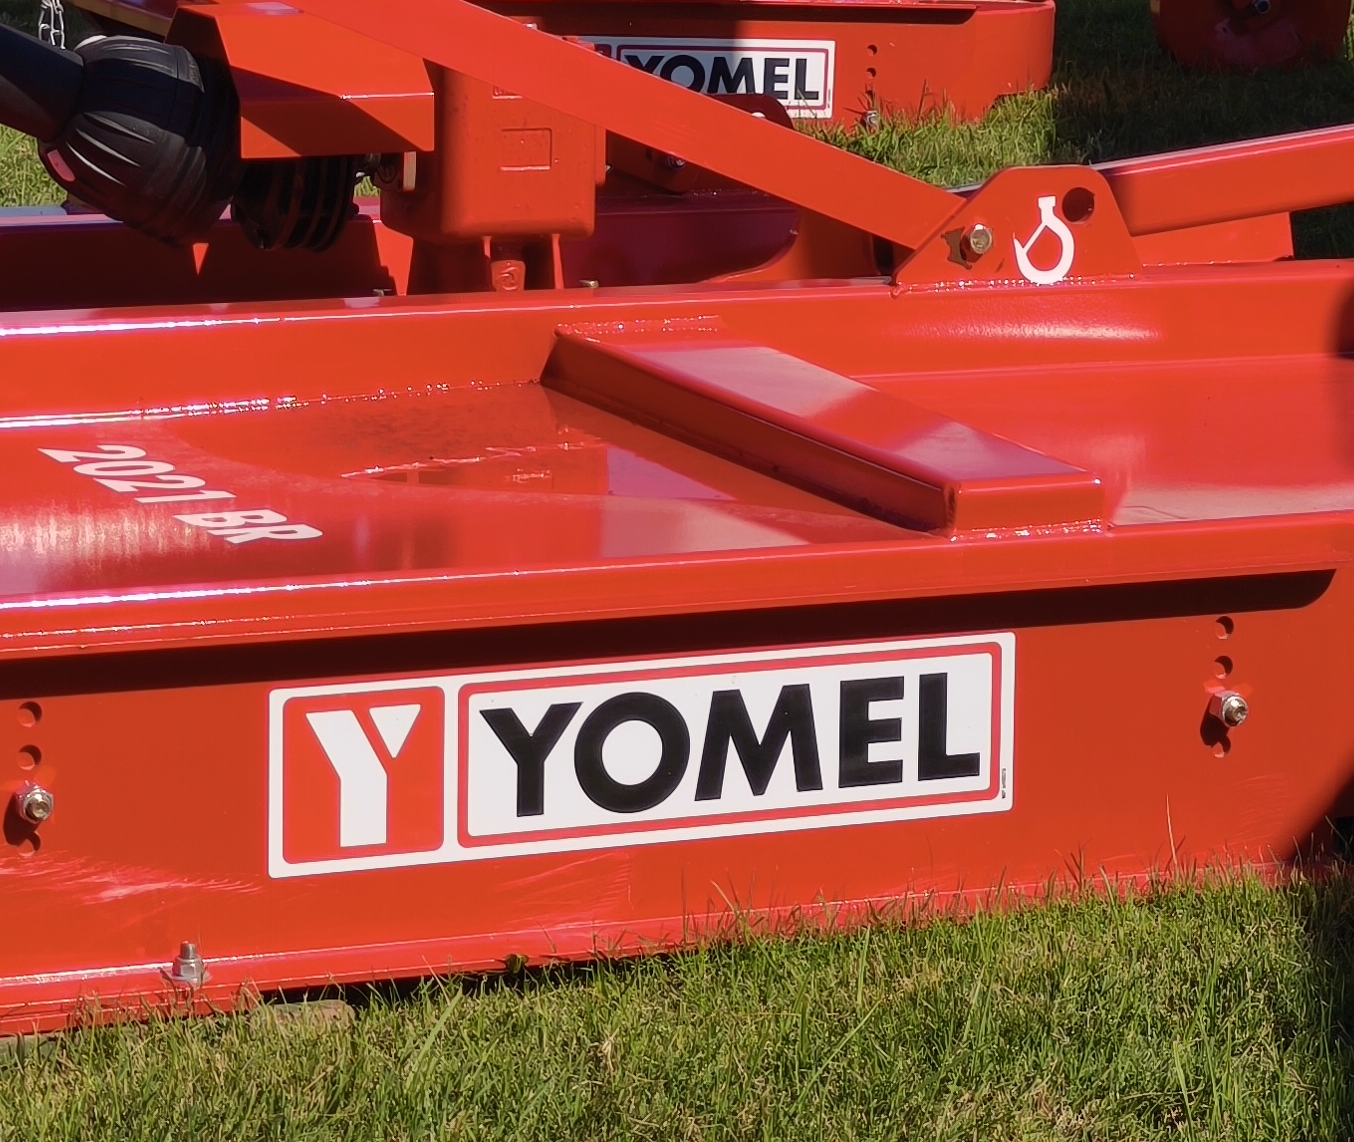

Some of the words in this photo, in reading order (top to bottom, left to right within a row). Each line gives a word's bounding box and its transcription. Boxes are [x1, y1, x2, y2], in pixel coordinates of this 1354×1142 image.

[37, 444, 237, 504] 2021
[173, 509, 324, 544] BR
[479, 671, 981, 818] YOMEL
